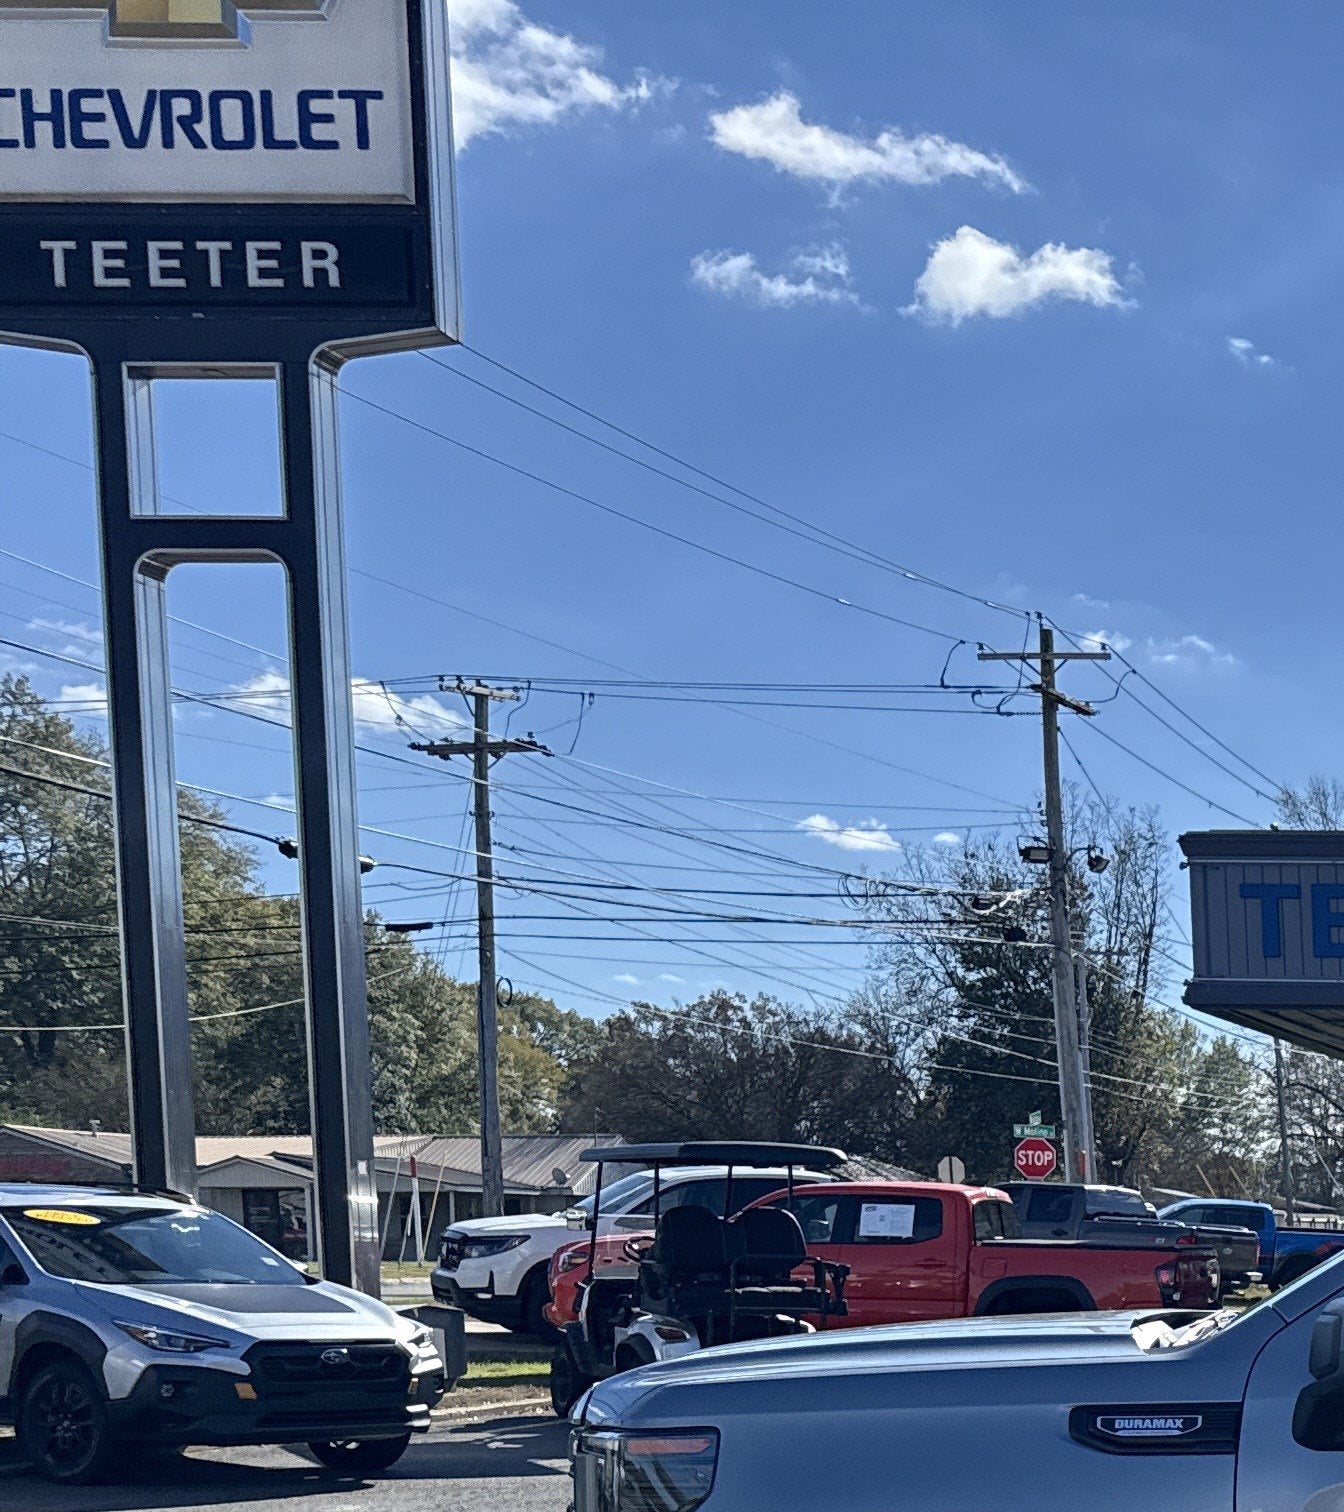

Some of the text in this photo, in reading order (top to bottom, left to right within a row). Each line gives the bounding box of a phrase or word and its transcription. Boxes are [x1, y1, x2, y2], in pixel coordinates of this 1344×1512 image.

[40, 240, 342, 289] TEETER
[1018, 1150, 1053, 1166] STOP
[1115, 1419, 1184, 1429] DURAMAX
